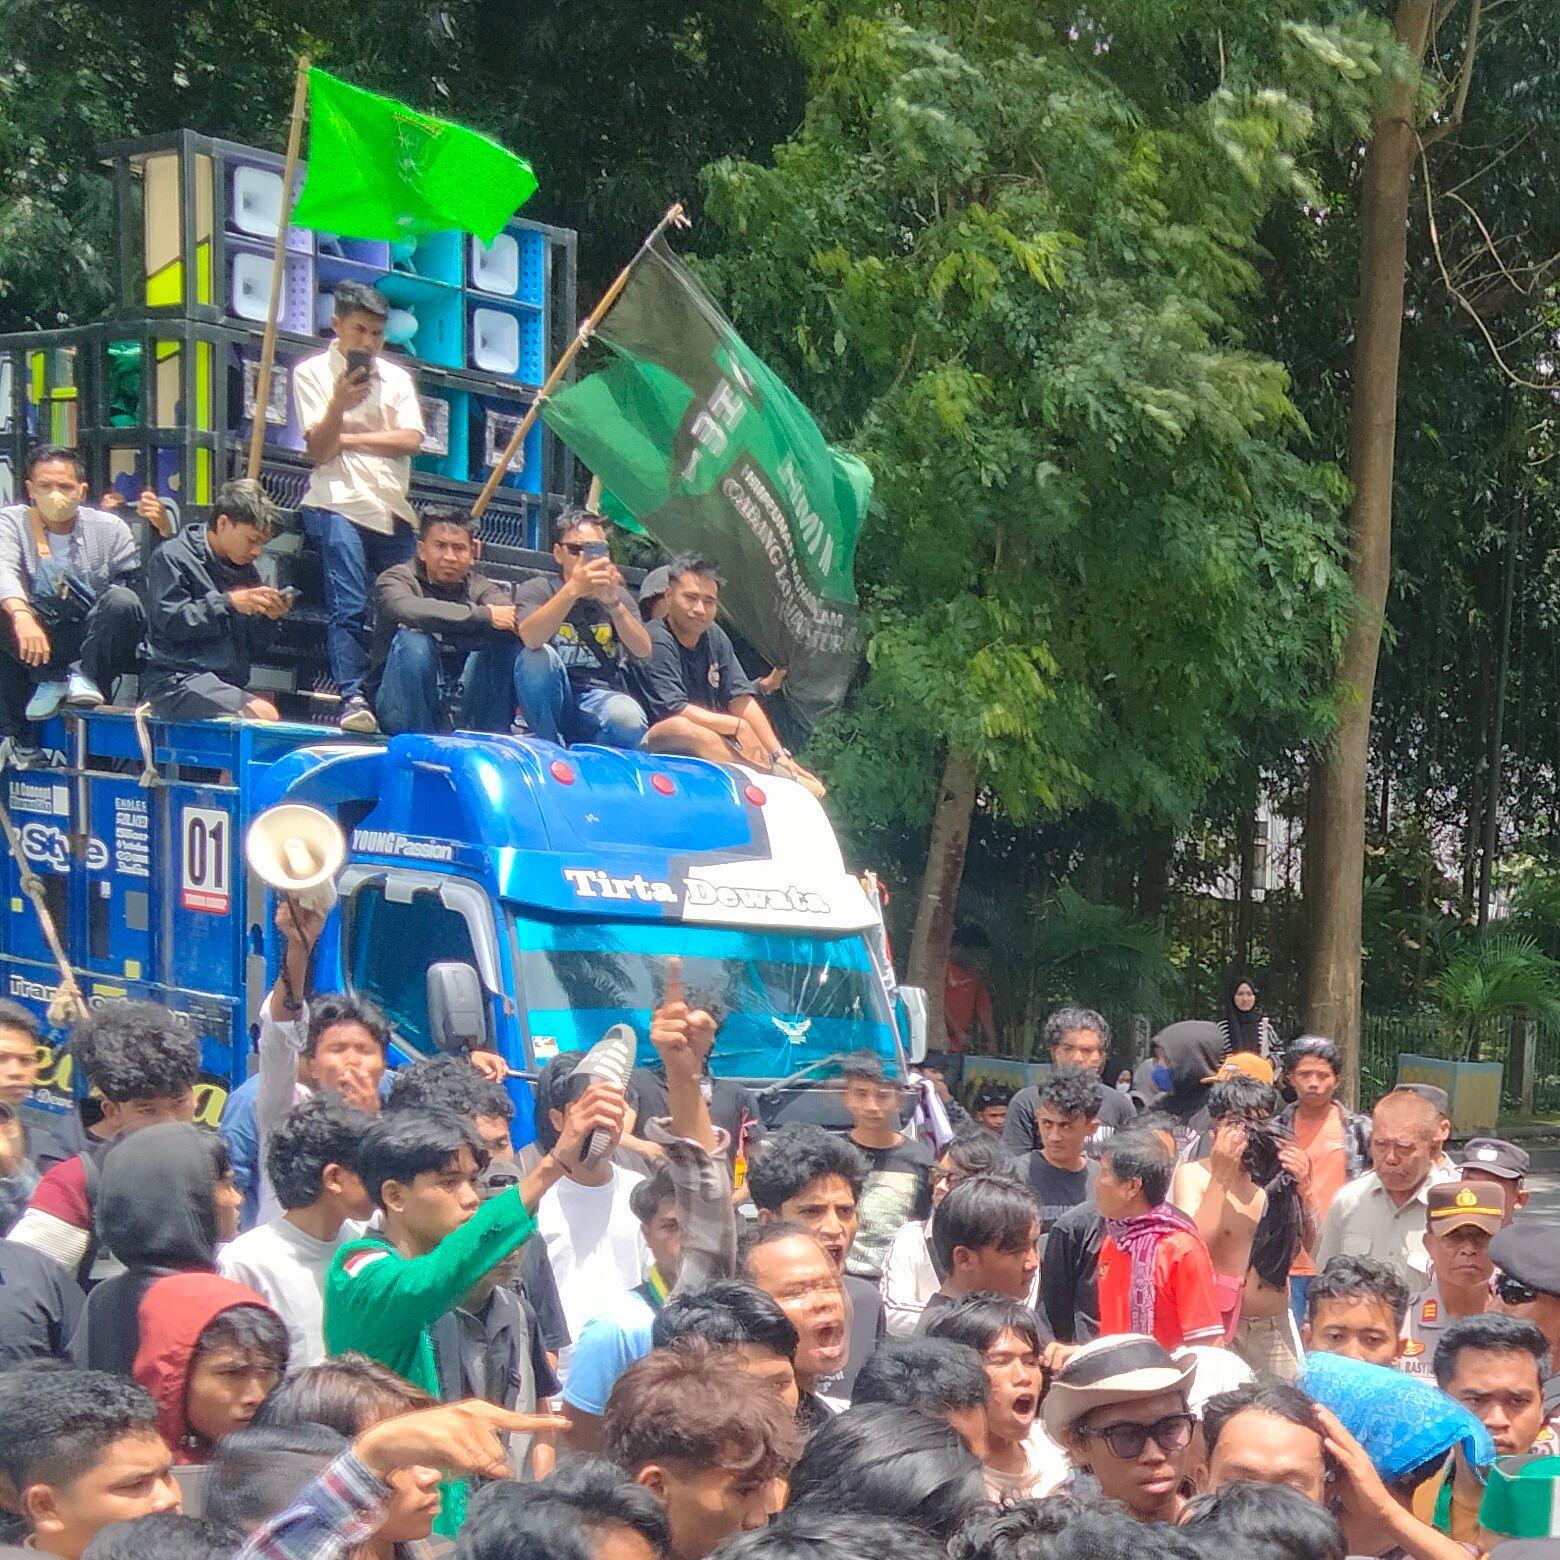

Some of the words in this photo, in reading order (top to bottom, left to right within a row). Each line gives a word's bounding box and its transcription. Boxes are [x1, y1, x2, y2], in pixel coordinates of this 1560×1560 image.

[187, 816, 226, 889] 01
[352, 829, 396, 854] YOUNG
[394, 836, 453, 861] Passion
[563, 867, 678, 903] Tirta
[682, 877, 831, 914] Dewata
